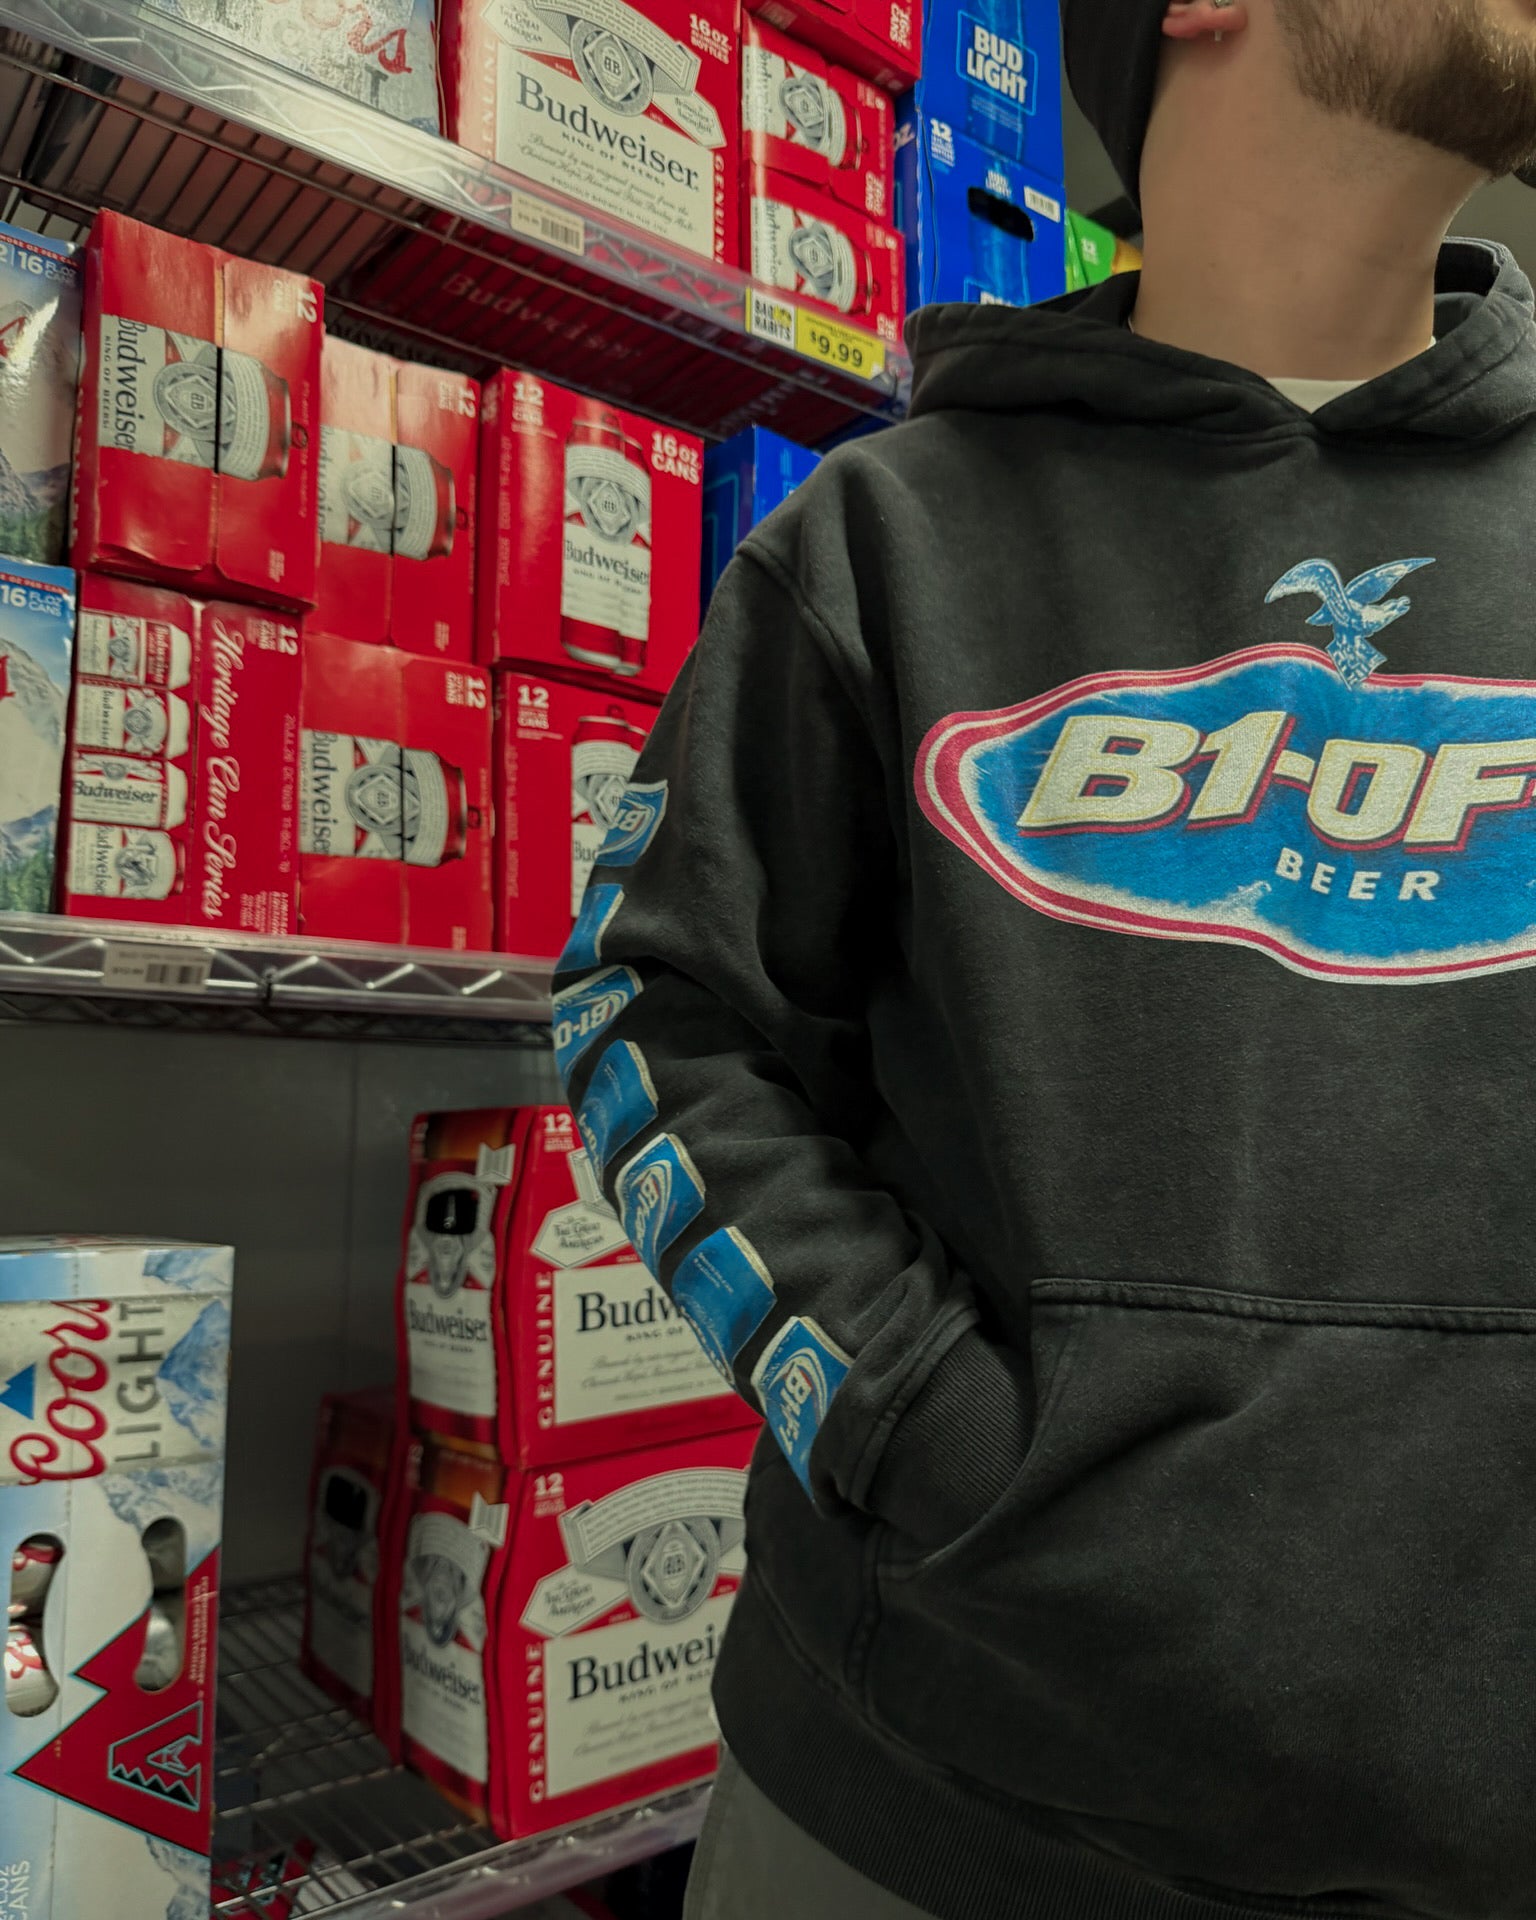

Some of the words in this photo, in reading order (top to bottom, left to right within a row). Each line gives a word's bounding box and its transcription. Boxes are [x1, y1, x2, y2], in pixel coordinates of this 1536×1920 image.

[690, 13, 710, 36] 16
[974, 24, 1023, 73] BUD
[966, 47, 1028, 105] LIGHT
[515, 70, 700, 191] Budweiser
[929, 117, 952, 142] 12
[18, 250, 44, 275] 16
[297, 287, 318, 323] 12
[810, 329, 864, 368] $9.99
[114, 316, 149, 450] Budweiser
[512, 380, 545, 408] 12
[458, 387, 476, 419] 12
[651, 430, 678, 458] 16
[651, 453, 700, 486] CANS
[0, 584, 27, 608] 16
[279, 623, 299, 656] 12
[201, 617, 246, 749] Heritage
[467, 675, 487, 710] 12
[517, 684, 550, 709] 12
[73, 779, 160, 807] Budweiser
[205, 754, 242, 821] Can
[201, 820, 242, 920] Series
[1274, 847, 1440, 901] BEER
[544, 1113, 573, 1134] 12
[536, 1271, 556, 1431] GENUINE
[114, 1302, 165, 1463] LIGHT
[533, 1471, 565, 1496] 12
[567, 1622, 722, 1703] Budwei
[525, 1641, 548, 1804] GENUINE
